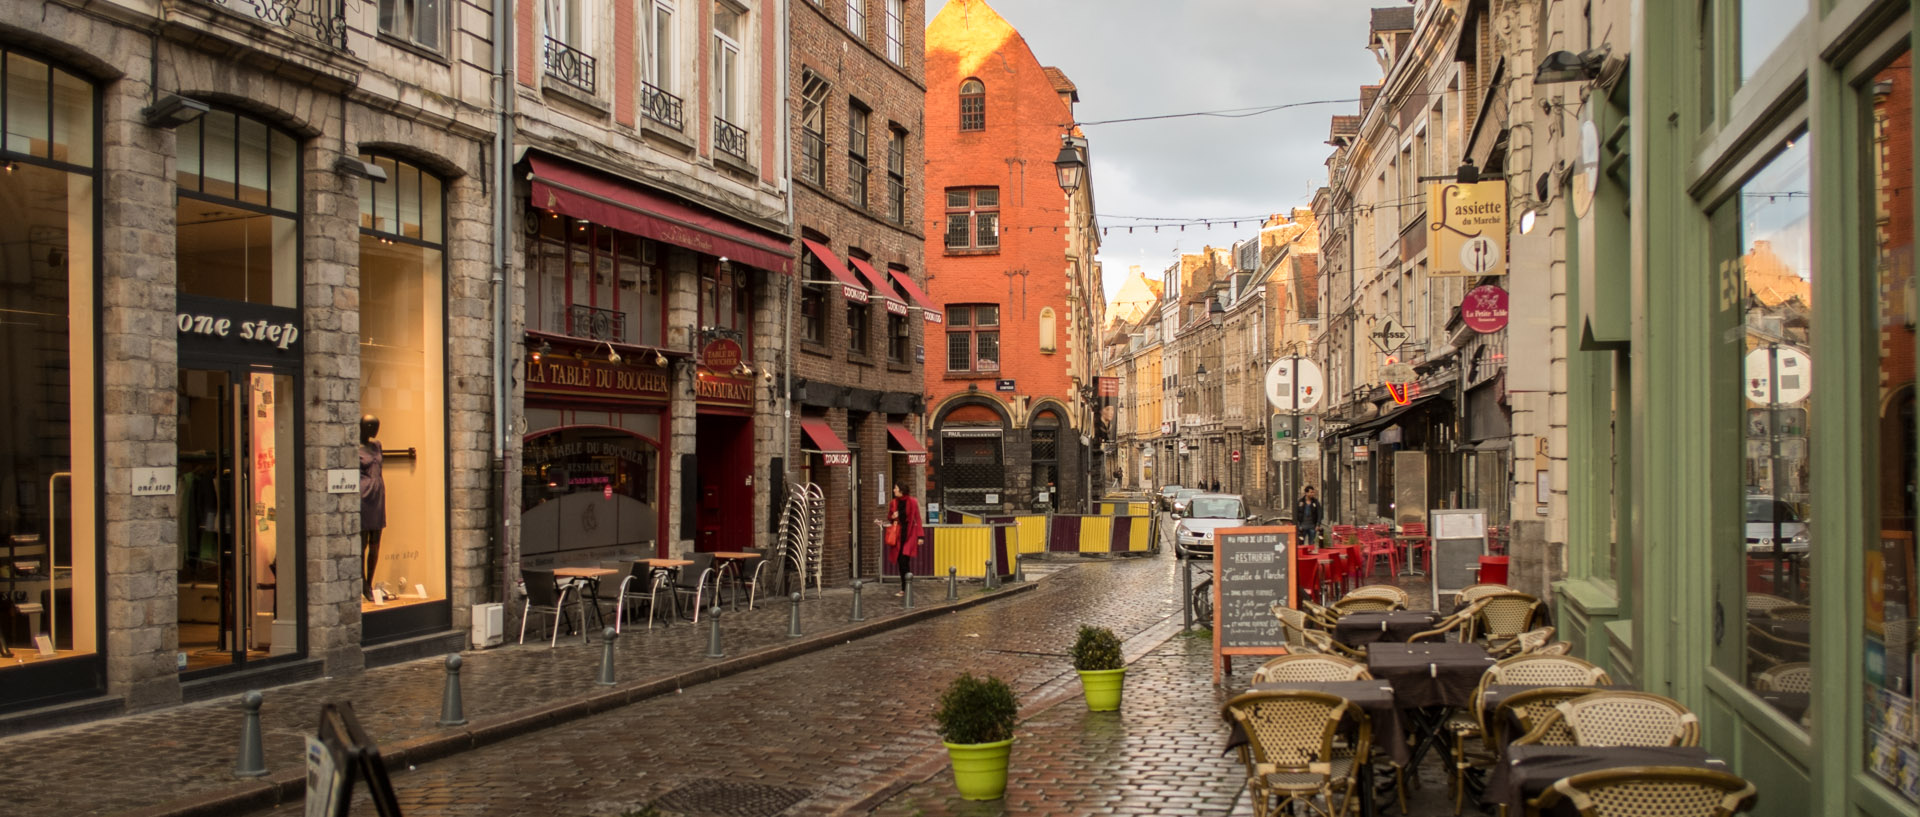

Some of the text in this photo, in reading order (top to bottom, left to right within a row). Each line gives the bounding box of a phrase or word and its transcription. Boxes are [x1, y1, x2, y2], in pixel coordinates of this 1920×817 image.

[1462, 216, 1501, 226] du Marché
[1465, 310, 1474, 318] La
[1474, 309, 1491, 317] Petite
[177, 313, 298, 350] one step
[708, 350, 737, 358] TABLE DU
[708, 358, 737, 366] BOUCHER
[527, 362, 668, 393] LA TABLE DU BOUCHER
[696, 380, 753, 401] RESTAURANT
[553, 442, 583, 457] TABLE
[587, 442, 599, 453] DU
[603, 443, 644, 464] BOUCHER
[137, 483, 172, 493] one step
[344, 483, 357, 492] step
[385, 550, 420, 562] one step
